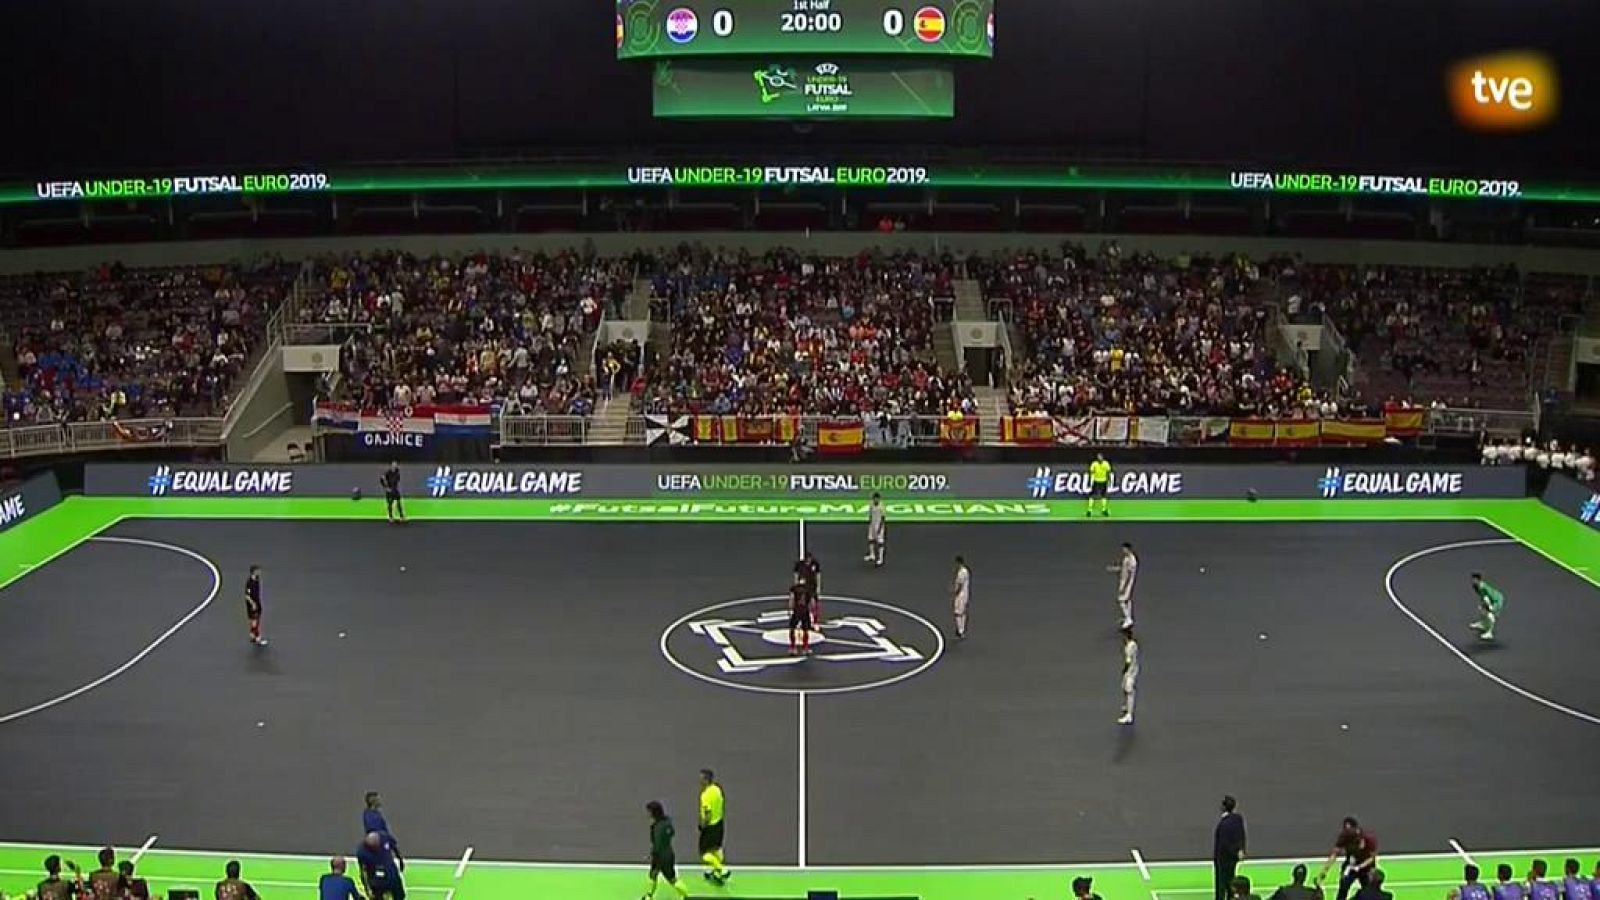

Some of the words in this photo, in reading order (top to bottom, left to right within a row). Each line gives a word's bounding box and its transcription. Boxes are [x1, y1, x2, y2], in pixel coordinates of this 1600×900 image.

[713, 10, 733, 36] 0
[781, 13, 842, 31] 20:00
[883, 9, 903, 36] 0
[804, 84, 852, 95] FUTSAL
[37, 181, 84, 198] UEFA
[85, 178, 172, 197] UNDER-19
[173, 176, 243, 194] FUTSAL
[243, 174, 289, 191] EURO
[627, 167, 673, 184] UEFA
[674, 167, 762, 184] UNDER-19
[764, 167, 835, 184] FUTSAL
[836, 167, 886, 184] EURO
[1230, 172, 1274, 189] UEFA
[1275, 174, 1357, 191] UNDER-19
[1358, 176, 1428, 193] FUTSAL
[1428, 178, 1478, 195] EURO
[657, 474, 701, 490] UEFA
[702, 474, 788, 490] UNDER-19
[790, 474, 859, 490] FUTSAL
[860, 474, 907, 490] EURO
[1026, 466, 1120, 498] #EQUL
